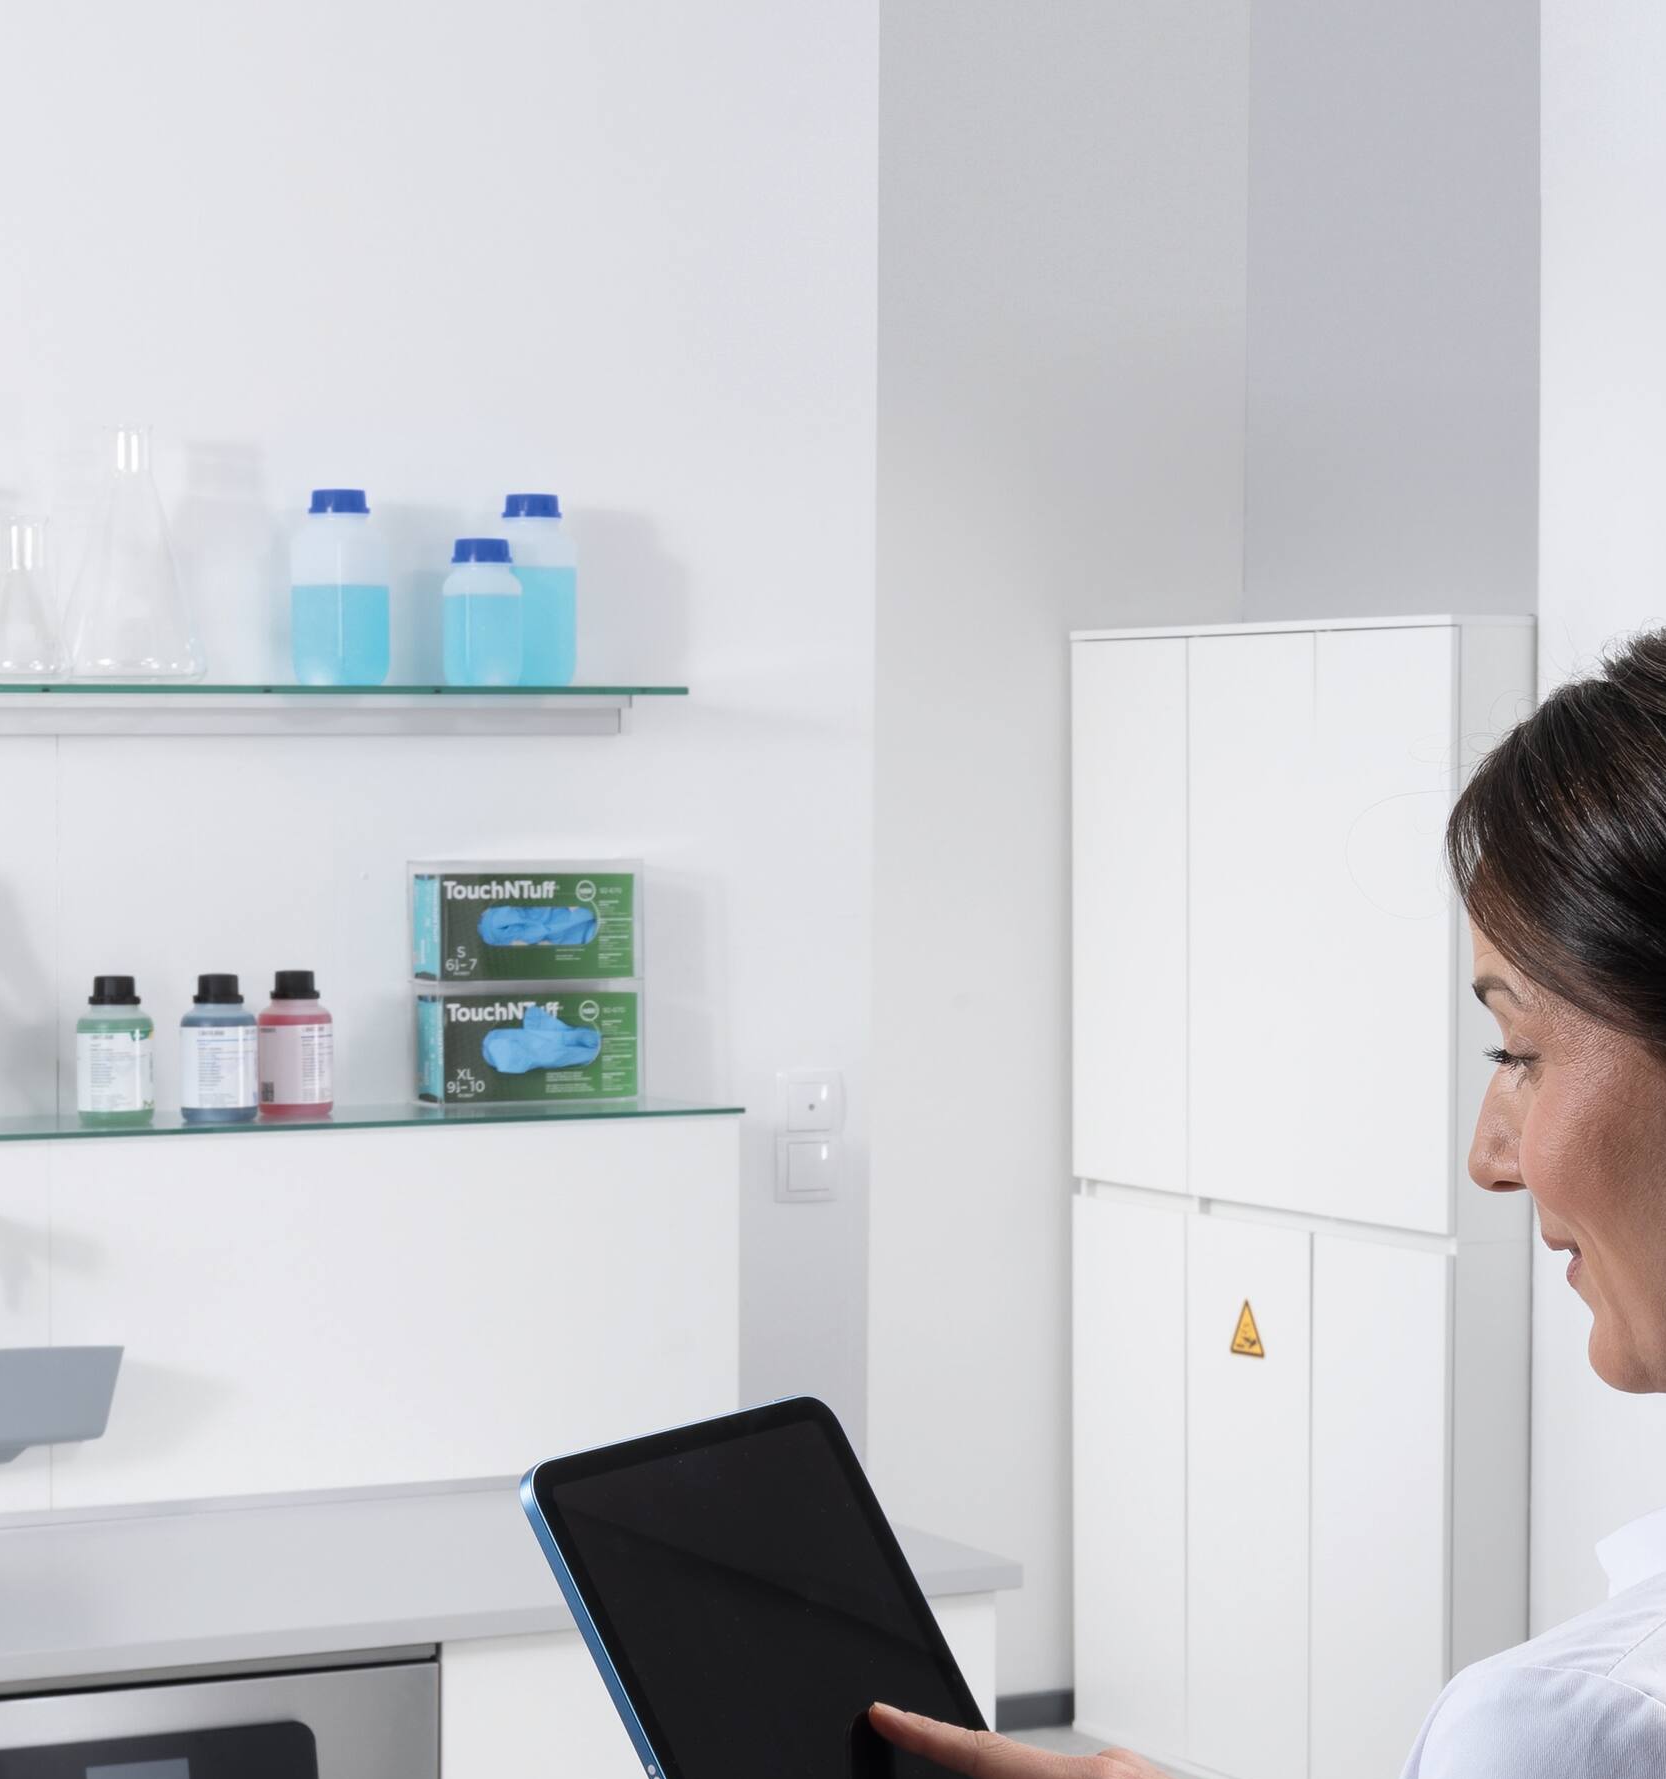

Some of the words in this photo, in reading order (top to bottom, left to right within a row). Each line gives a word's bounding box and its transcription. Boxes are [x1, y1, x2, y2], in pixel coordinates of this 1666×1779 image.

[442, 879, 557, 900] TouchNTuff
[456, 945, 466, 959] S
[446, 1001, 560, 1022] TouchNff
[456, 1069, 475, 1081] XL
